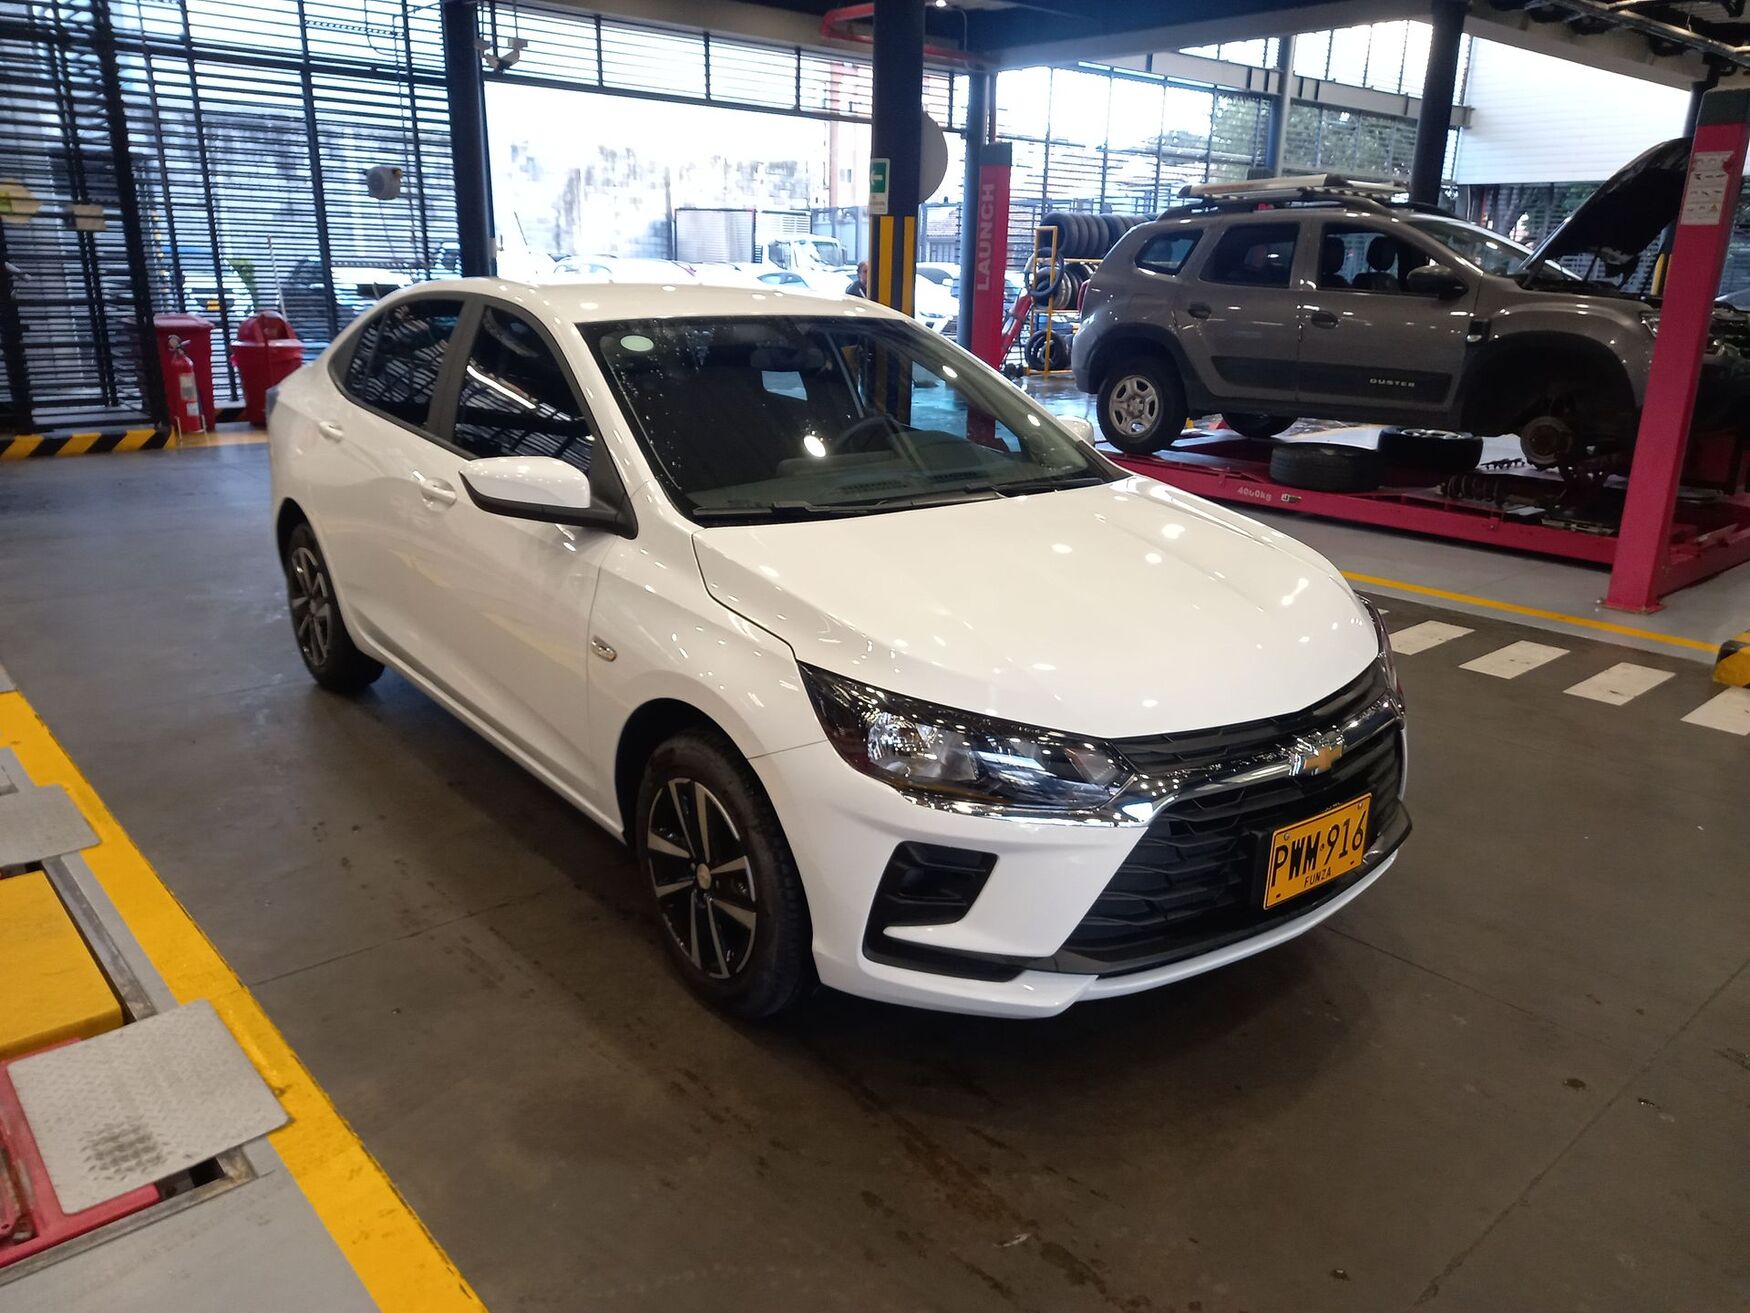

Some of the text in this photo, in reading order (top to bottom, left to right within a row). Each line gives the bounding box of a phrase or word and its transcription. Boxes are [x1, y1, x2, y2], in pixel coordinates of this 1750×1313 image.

[977, 184, 995, 291] LAUNCH
[1369, 378, 1416, 388] DUSTER
[1303, 867, 1332, 888] FUNZA
